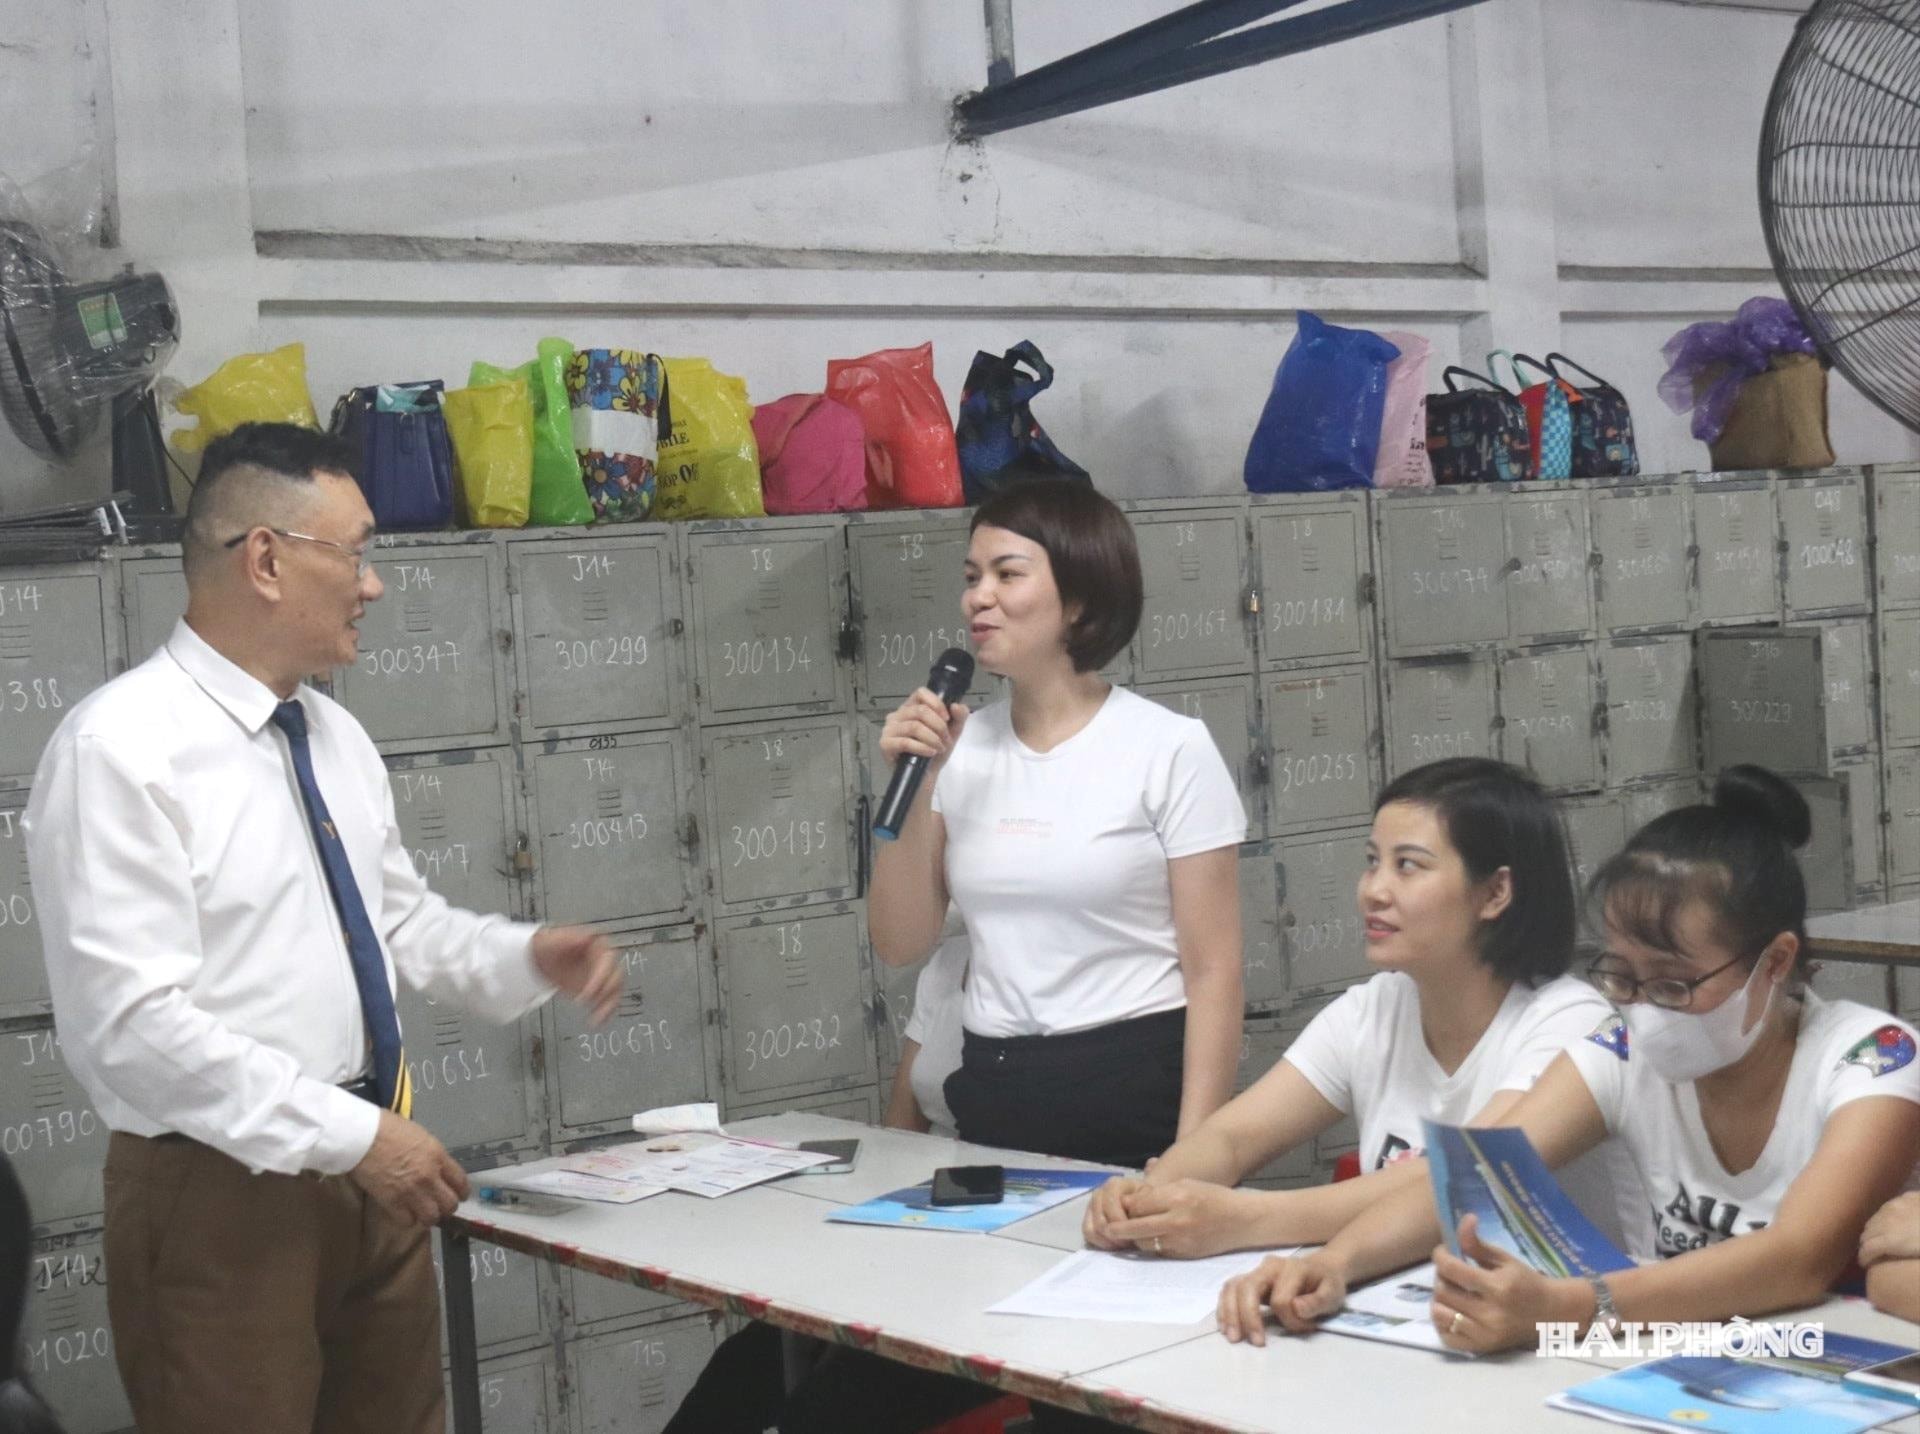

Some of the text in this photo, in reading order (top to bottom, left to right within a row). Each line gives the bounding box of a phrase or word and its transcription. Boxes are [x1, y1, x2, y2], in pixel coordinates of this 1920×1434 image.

[900, 533, 925, 562] J8
[1176, 522, 1196, 547] J8
[567, 553, 617, 581] J14
[750, 548, 775, 571] J8
[394, 565, 436, 592] J14
[365, 641, 462, 676] 300347
[554, 634, 648, 672] 300299
[722, 636, 814, 678] 300134
[0, 676, 64, 712] 388
[397, 773, 443, 802] J14
[1282, 753, 1356, 793] 300265
[568, 813, 648, 850] 300413
[776, 923, 803, 956] J8
[745, 1014, 842, 1072] 300282
